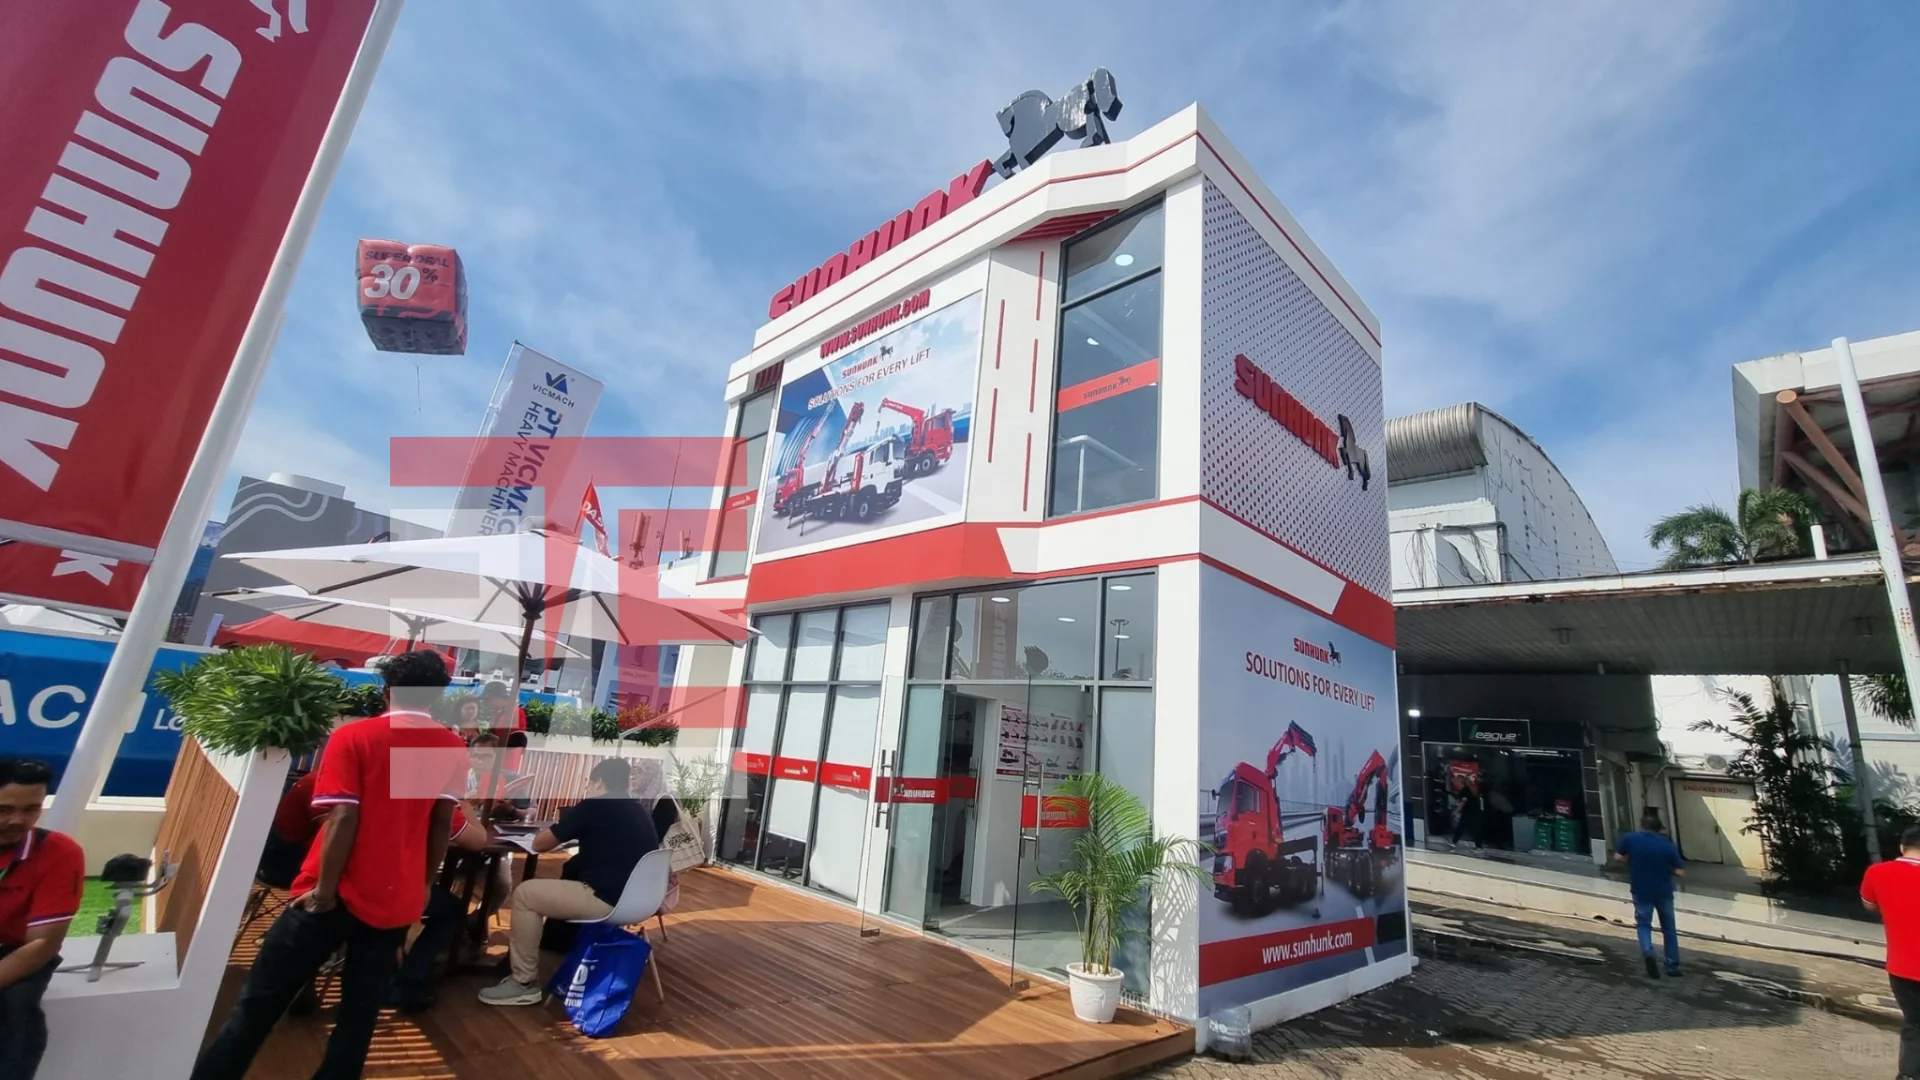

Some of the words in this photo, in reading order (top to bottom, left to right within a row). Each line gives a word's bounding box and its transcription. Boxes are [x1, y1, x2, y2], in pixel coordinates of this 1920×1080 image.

[768, 159, 993, 320] SUNHUNK
[365, 251, 412, 263] SUPER
[415, 254, 449, 267] DEAL
[820, 288, 931, 359] WWW.SUNHUNK.COM
[807, 380, 855, 410] SOLUTIONS
[857, 371, 876, 388] FOR
[877, 358, 908, 380] EVERY
[910, 347, 932, 365] LIFT
[842, 355, 878, 379] SUNHUNK
[532, 383, 575, 408] VICMACH
[1234, 353, 1340, 469] SUNHUNK
[513, 400, 543, 451] HEAVY
[537, 407, 563, 440] PT
[1294, 637, 1330, 664] SUNHUNK
[1246, 651, 1310, 691] SOLUTIONS
[1313, 674, 1331, 698] FOR
[1333, 682, 1359, 707] EVERY
[1360, 693, 1376, 713] LIFT
[1683, 784, 1738, 794] ENGINEERING
[1262, 930, 1353, 965] www.sunhunk.com
